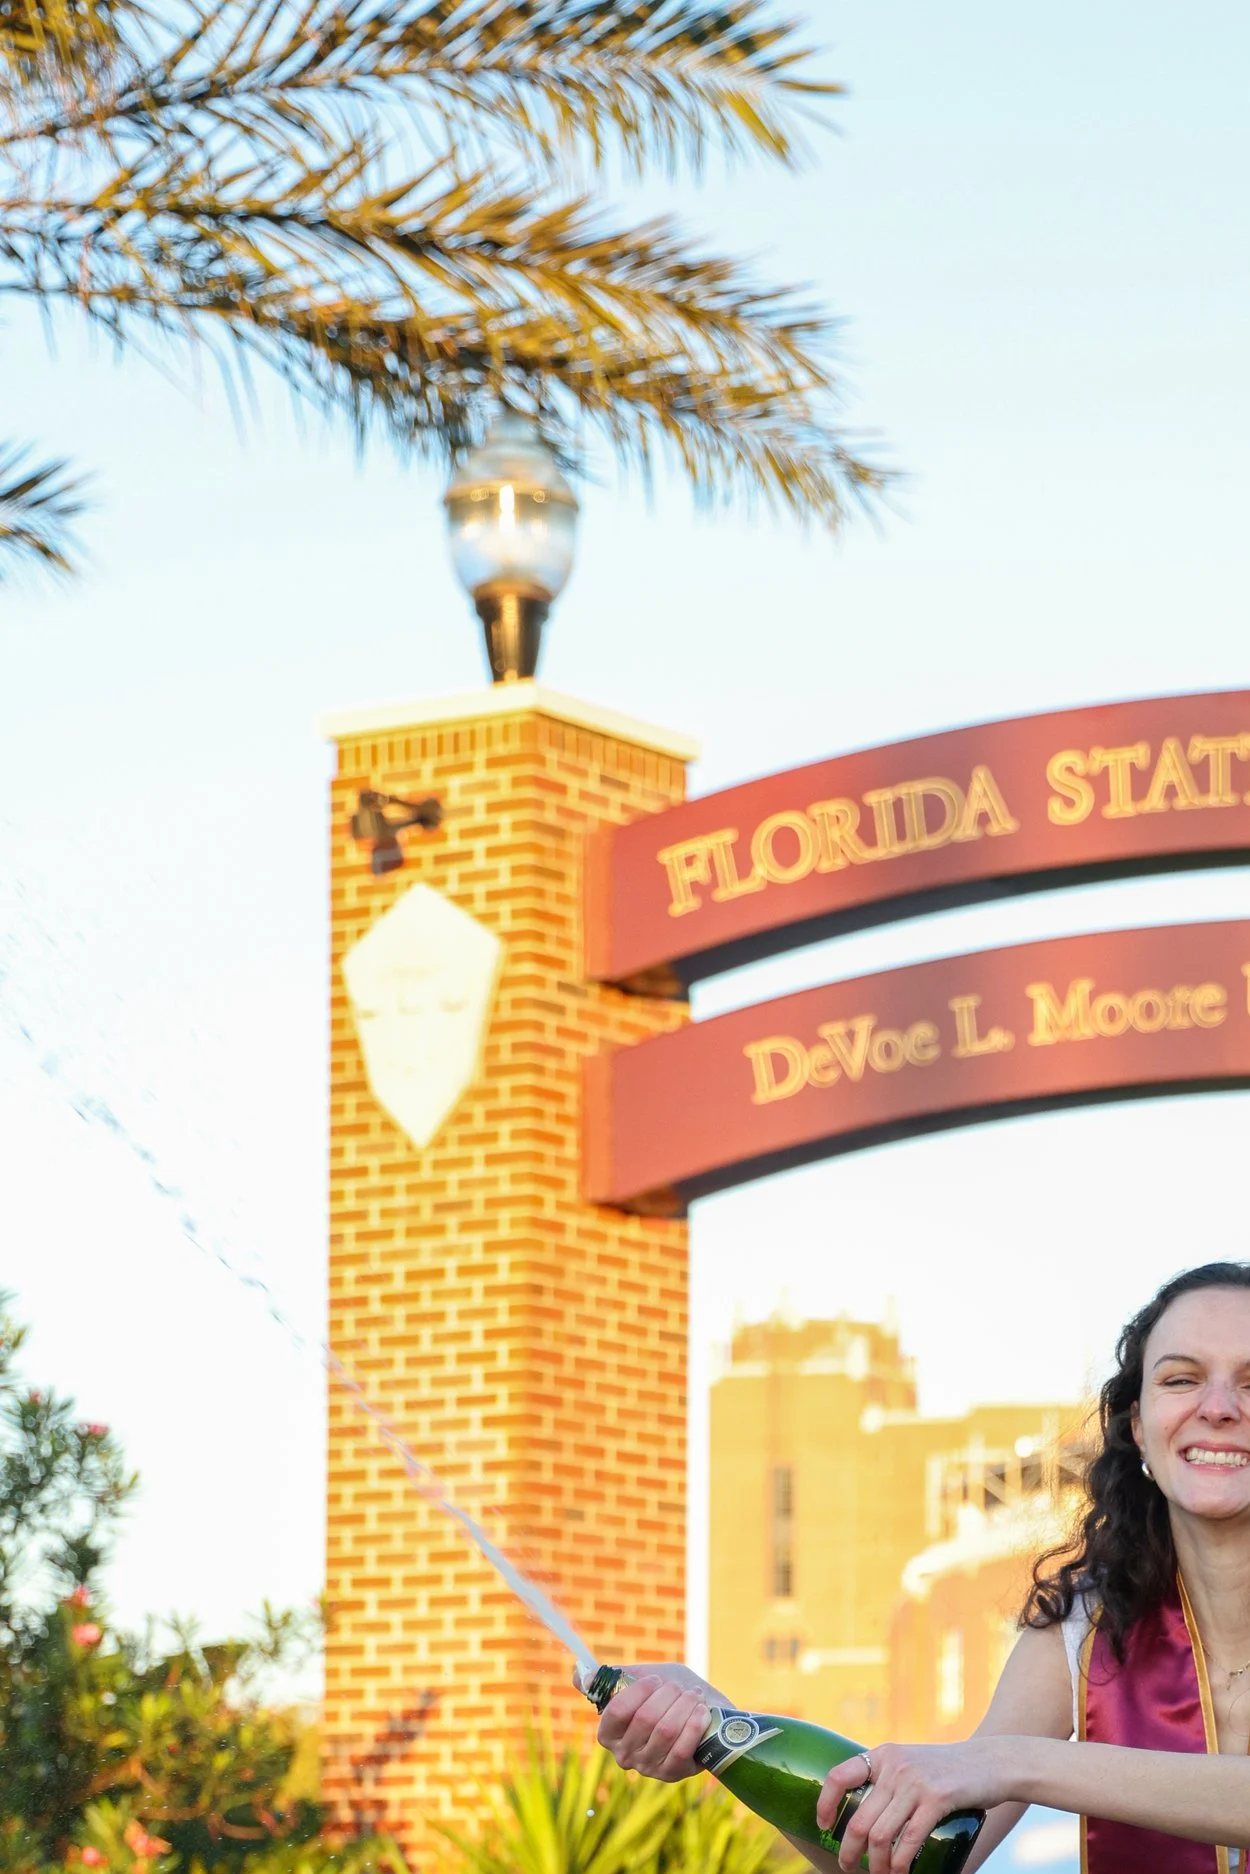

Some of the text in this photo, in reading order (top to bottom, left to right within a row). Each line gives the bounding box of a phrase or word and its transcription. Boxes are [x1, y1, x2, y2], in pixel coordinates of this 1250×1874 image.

[657, 765, 1018, 916] FLORIDA
[743, 1014, 940, 1105] DeVoe
[1026, 978, 1228, 1046] Moore
